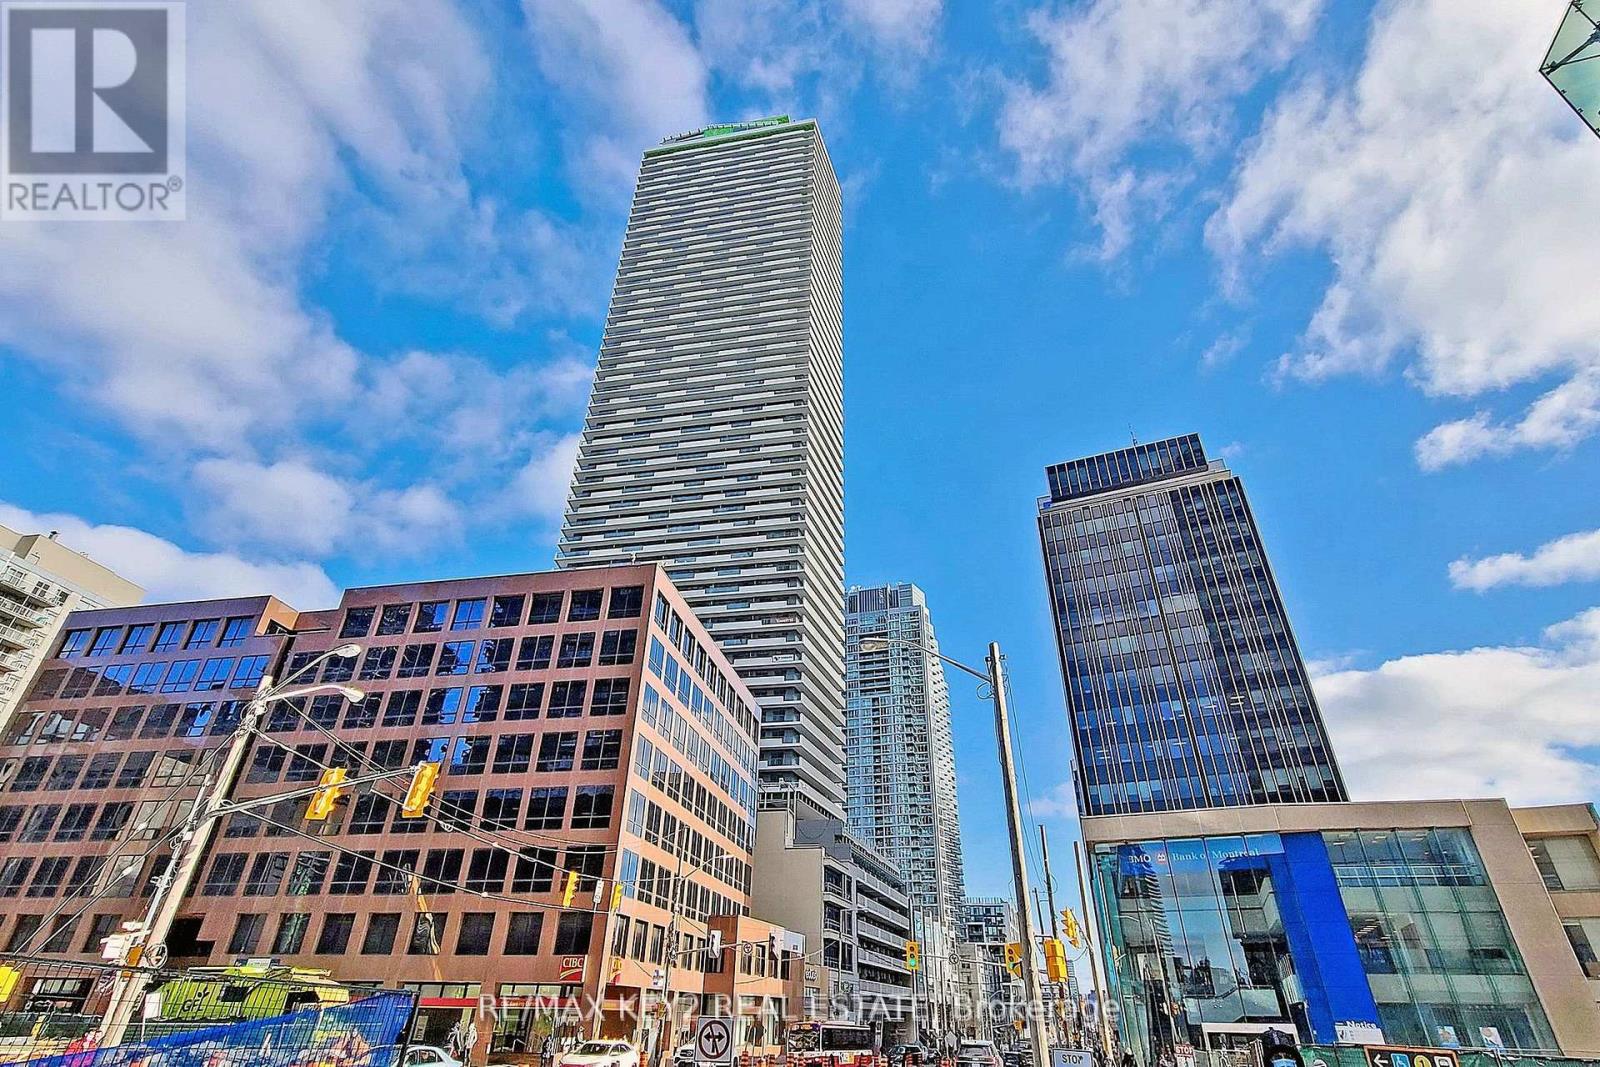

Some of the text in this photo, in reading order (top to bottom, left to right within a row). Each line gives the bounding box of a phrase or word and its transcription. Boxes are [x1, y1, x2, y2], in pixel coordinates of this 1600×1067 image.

[1172, 851, 1199, 861] Bank
[1212, 848, 1261, 859] Montreal
[562, 957, 583, 968] CIBC
[182, 998, 204, 1013] GFL
